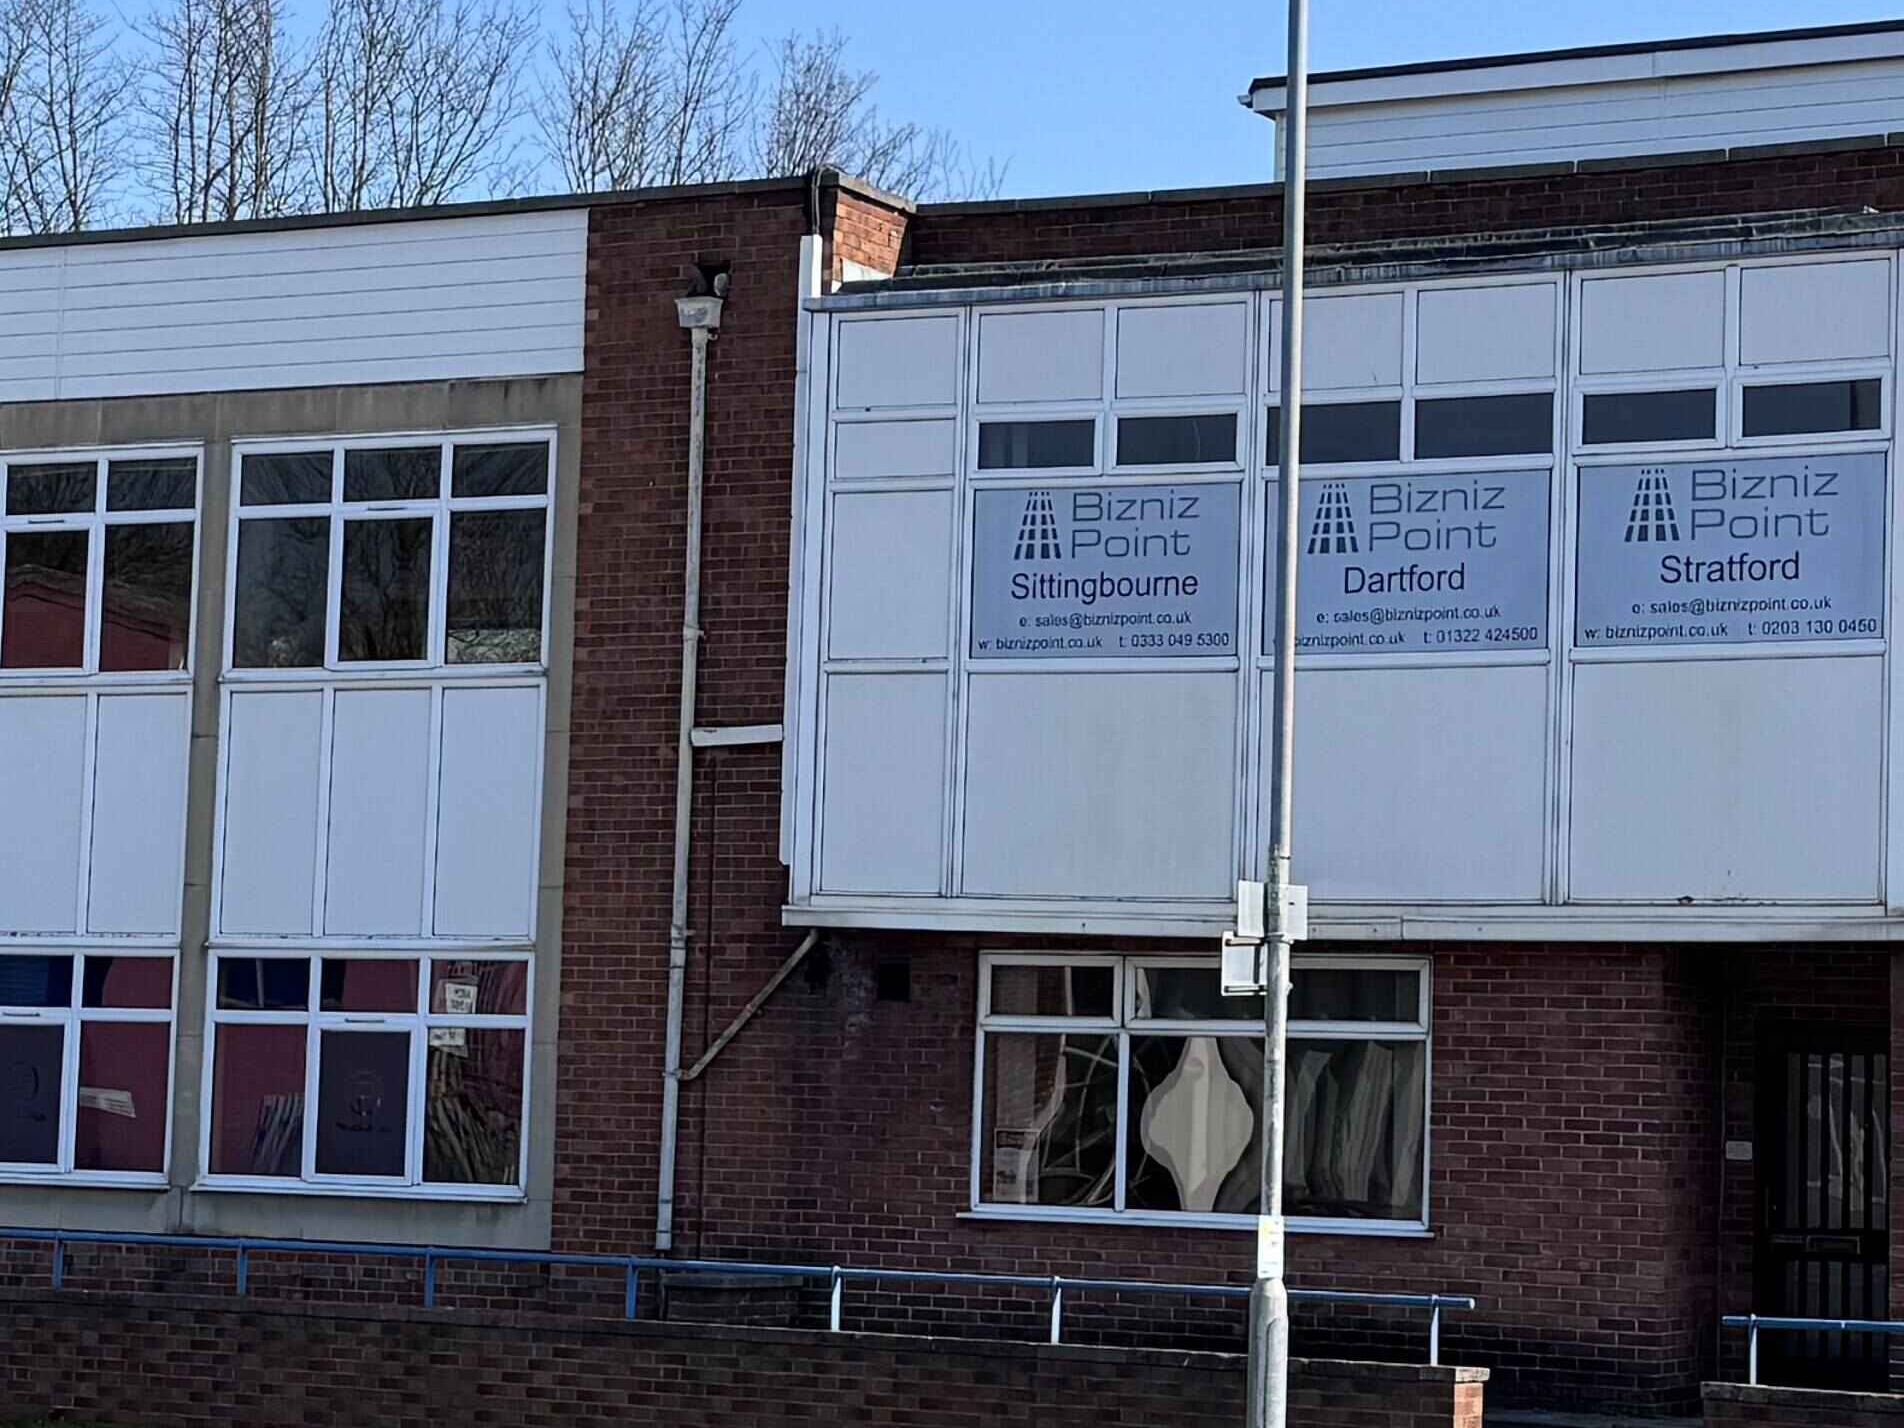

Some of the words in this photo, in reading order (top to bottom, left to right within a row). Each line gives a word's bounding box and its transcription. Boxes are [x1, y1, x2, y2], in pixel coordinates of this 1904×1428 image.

[1370, 480, 1505, 515] Bizniz
[1691, 465, 1839, 501] Bizniz
[1072, 489, 1200, 522] Bizniz
[1369, 519, 1497, 552] Point
[1691, 506, 1830, 541] Point
[1072, 527, 1191, 559] Point
[1344, 562, 1465, 594] Dartford
[1660, 551, 1800, 584] Stratford
[1011, 572, 1199, 605] Sittingbourne
[1035, 611, 1192, 629] sales@biznizpoint.co.uk
[1334, 605, 1501, 625] sales@biznizpoint.co.uk
[1650, 596, 1832, 616] sales@biznizpoint.co.uk
[996, 635, 1103, 651] biznizpoint.co.uk
[1131, 634, 1164, 647] 0333
[1168, 633, 1192, 647] 049
[1196, 632, 1229, 646] 5300
[1436, 628, 1480, 643] 01322
[1485, 627, 1538, 641] 424500
[1606, 622, 1728, 641] biznizpoint.co.uk
[1806, 619, 1833, 634] 130
